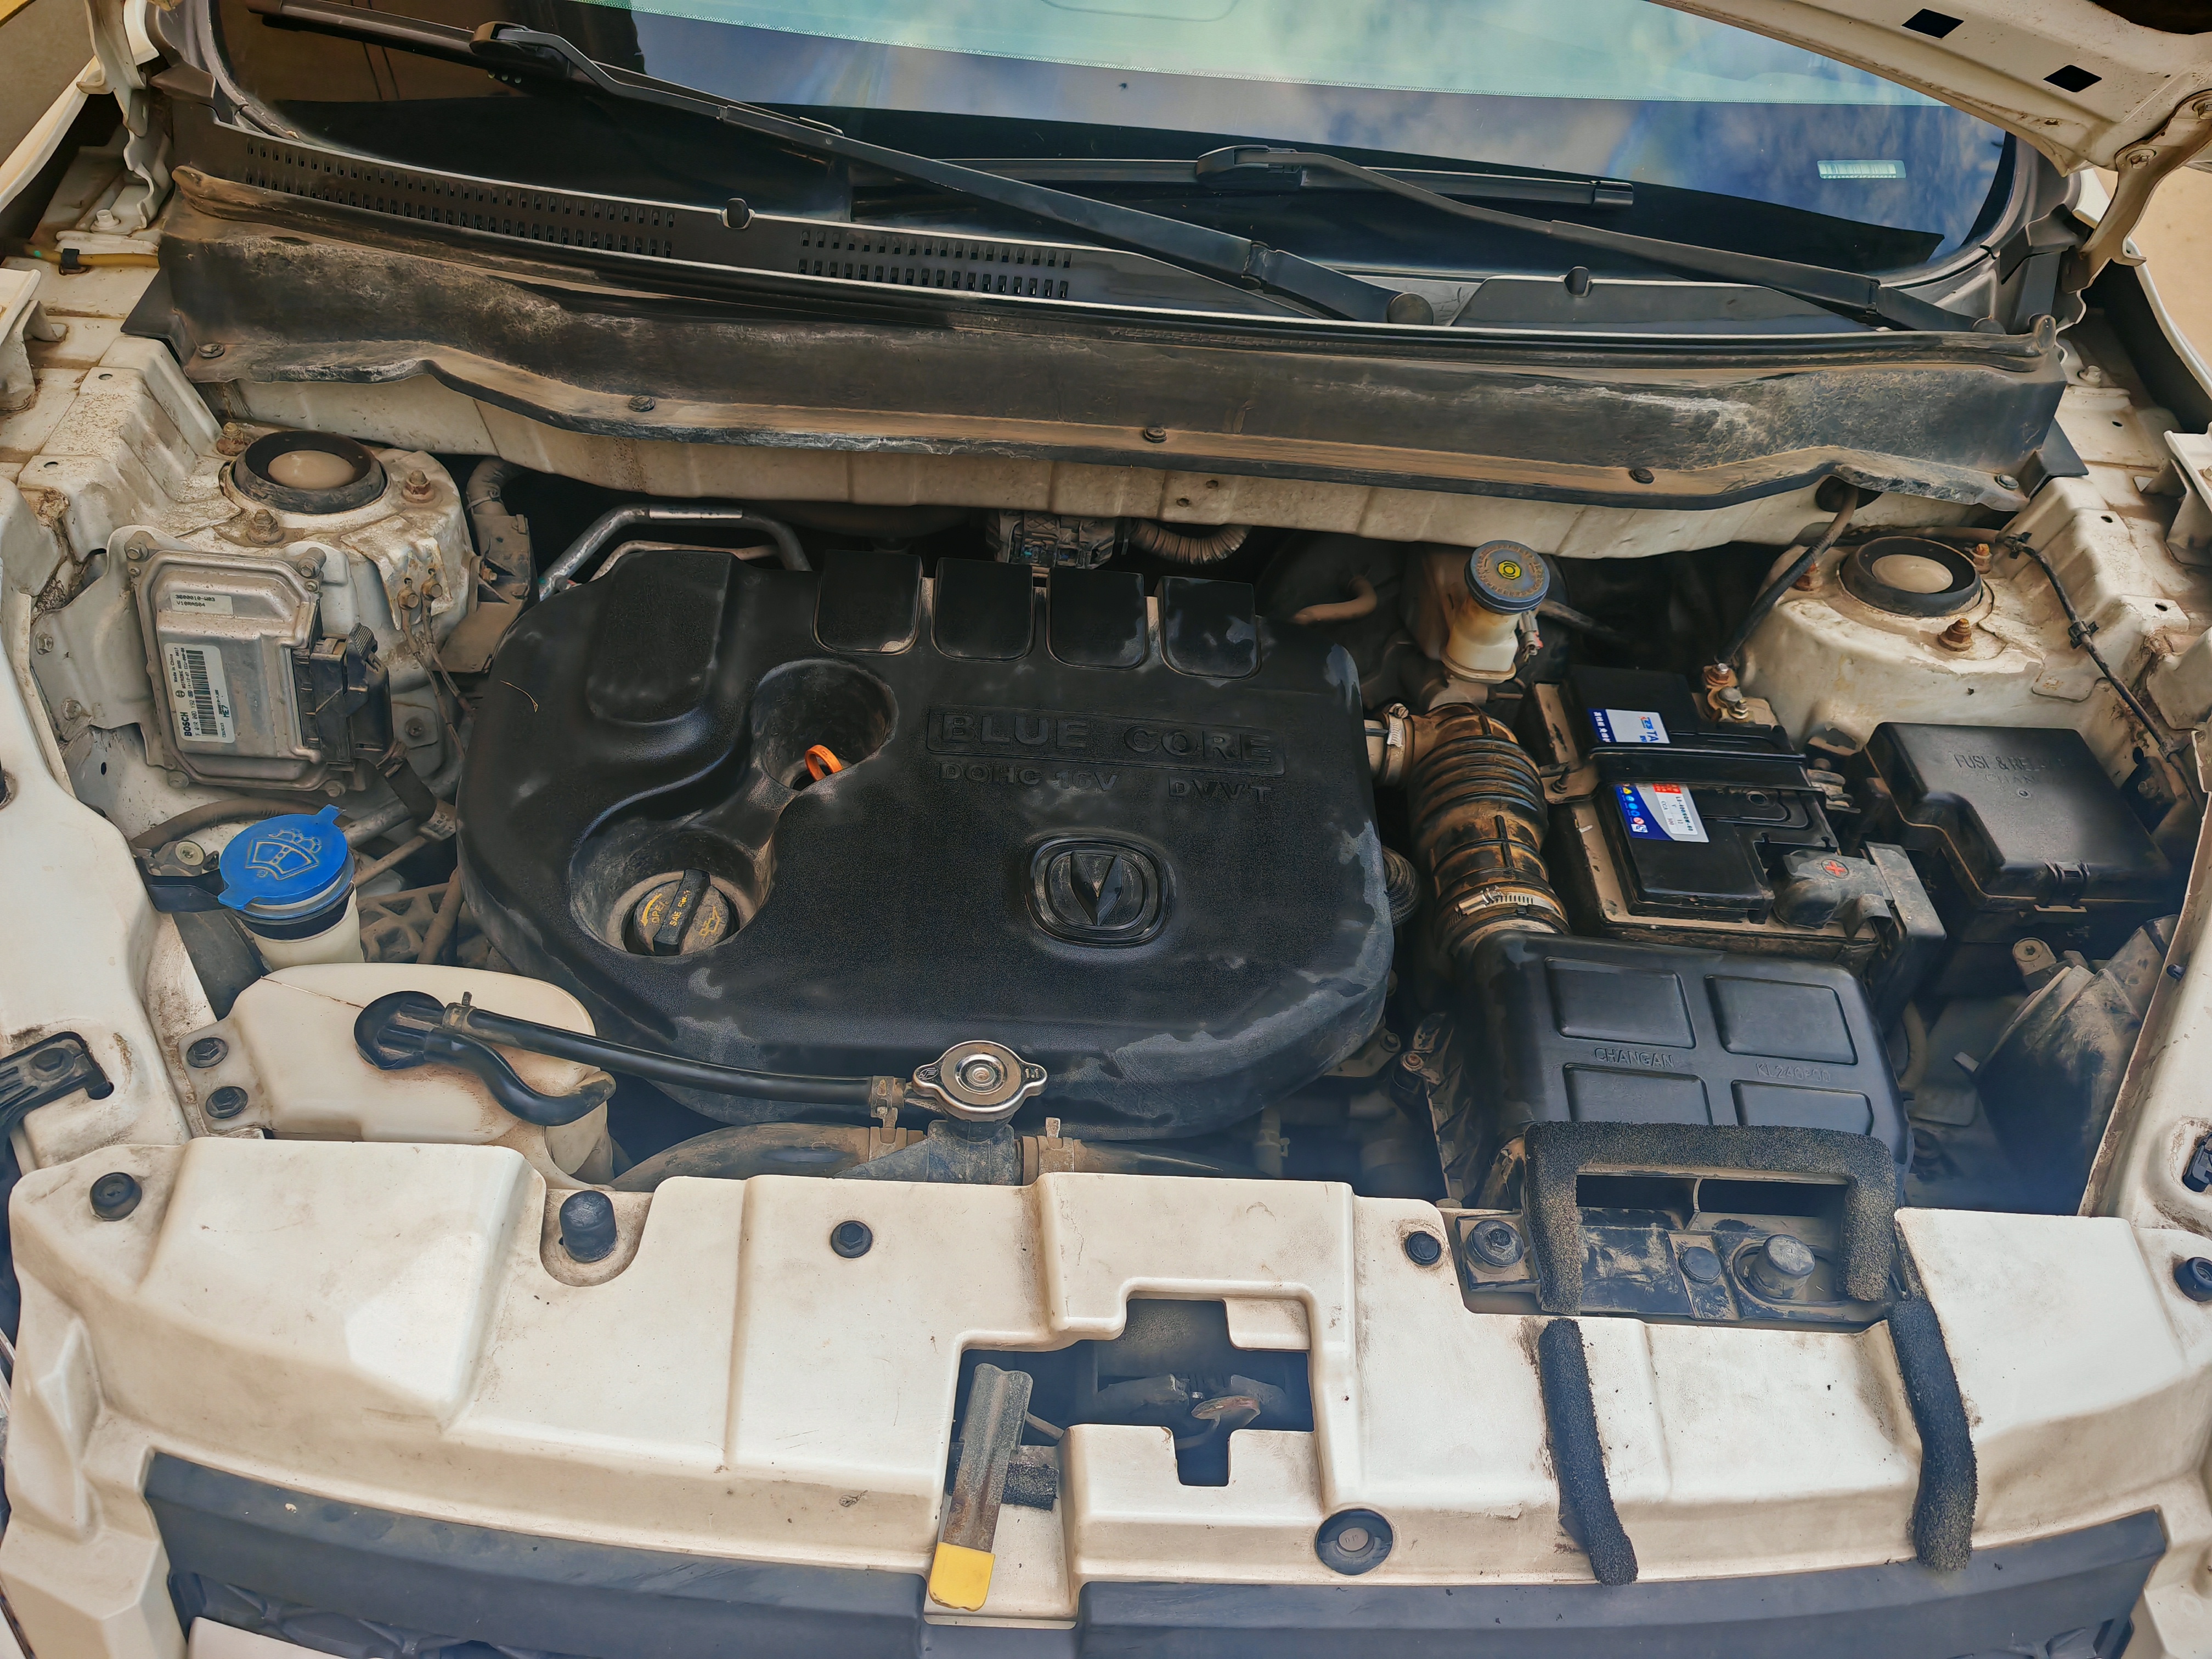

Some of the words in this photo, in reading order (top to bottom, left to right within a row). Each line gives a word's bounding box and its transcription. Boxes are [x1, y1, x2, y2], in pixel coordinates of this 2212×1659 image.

[222, 704, 230, 718] ME7
[180, 712, 192, 737] BOSCH
[941, 713, 1088, 749] BLUE
[1124, 725, 1273, 763] CORE
[939, 763, 1041, 786] DOHC
[1168, 777, 1273, 802] DVVT
[669, 911, 682, 927] SAE
[1594, 1047, 1674, 1068] CHANGAN
